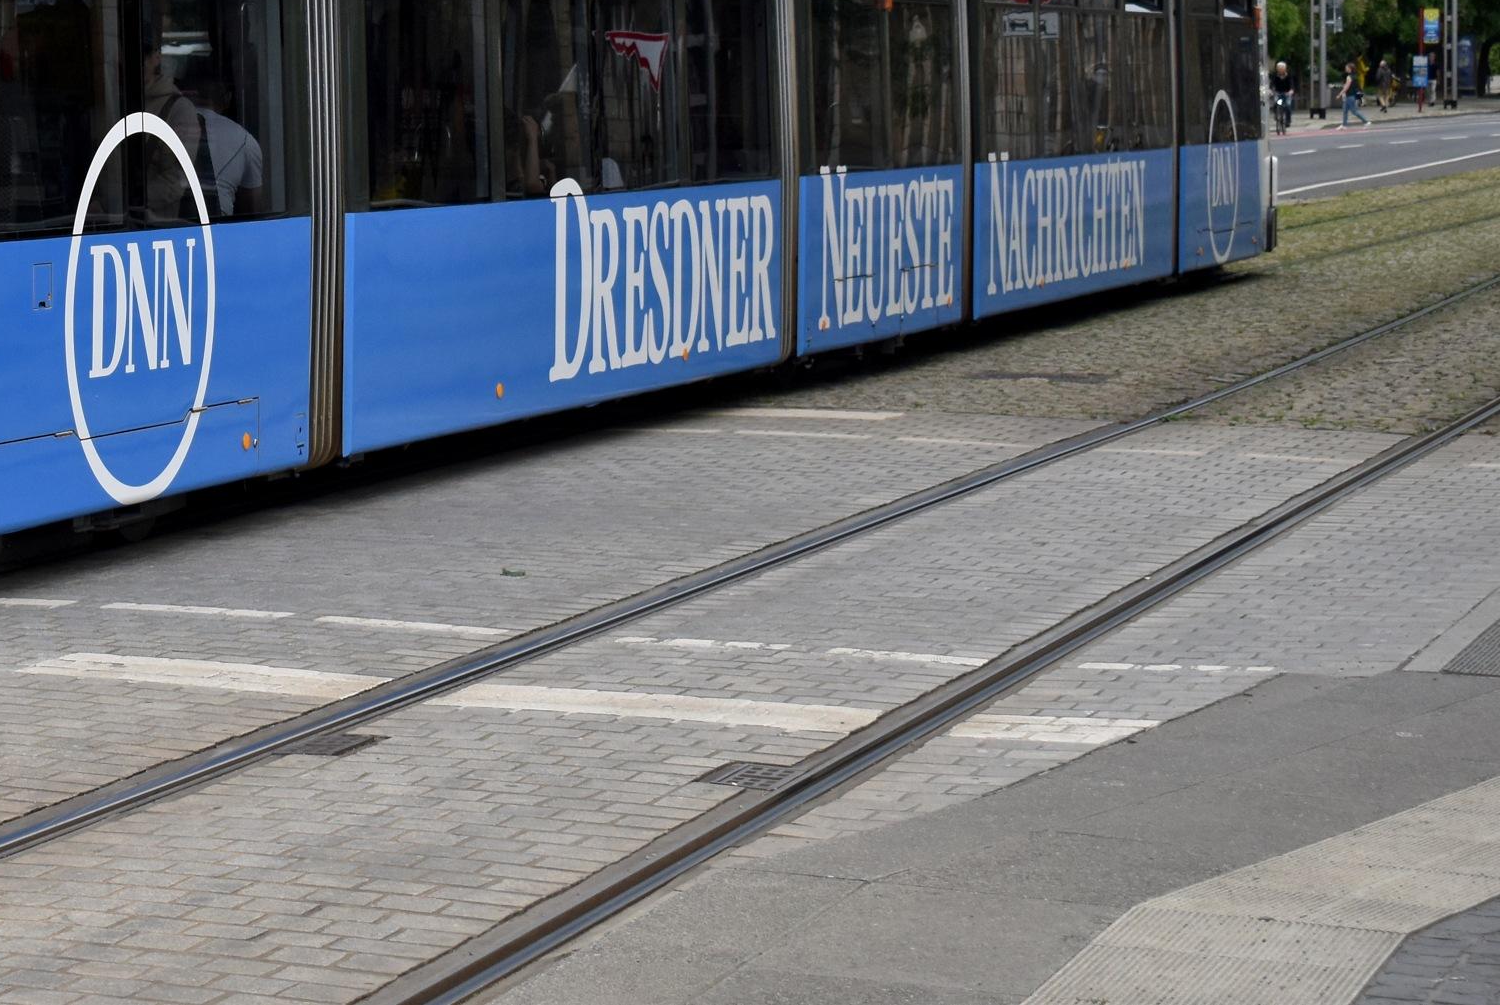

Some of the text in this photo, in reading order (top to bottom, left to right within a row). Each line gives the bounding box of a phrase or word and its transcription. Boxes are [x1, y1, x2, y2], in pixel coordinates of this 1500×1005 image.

[88, 238, 197, 378] DNN
[549, 151, 1148, 383] DRESDNER NEUESTE NACHRICHTEN
